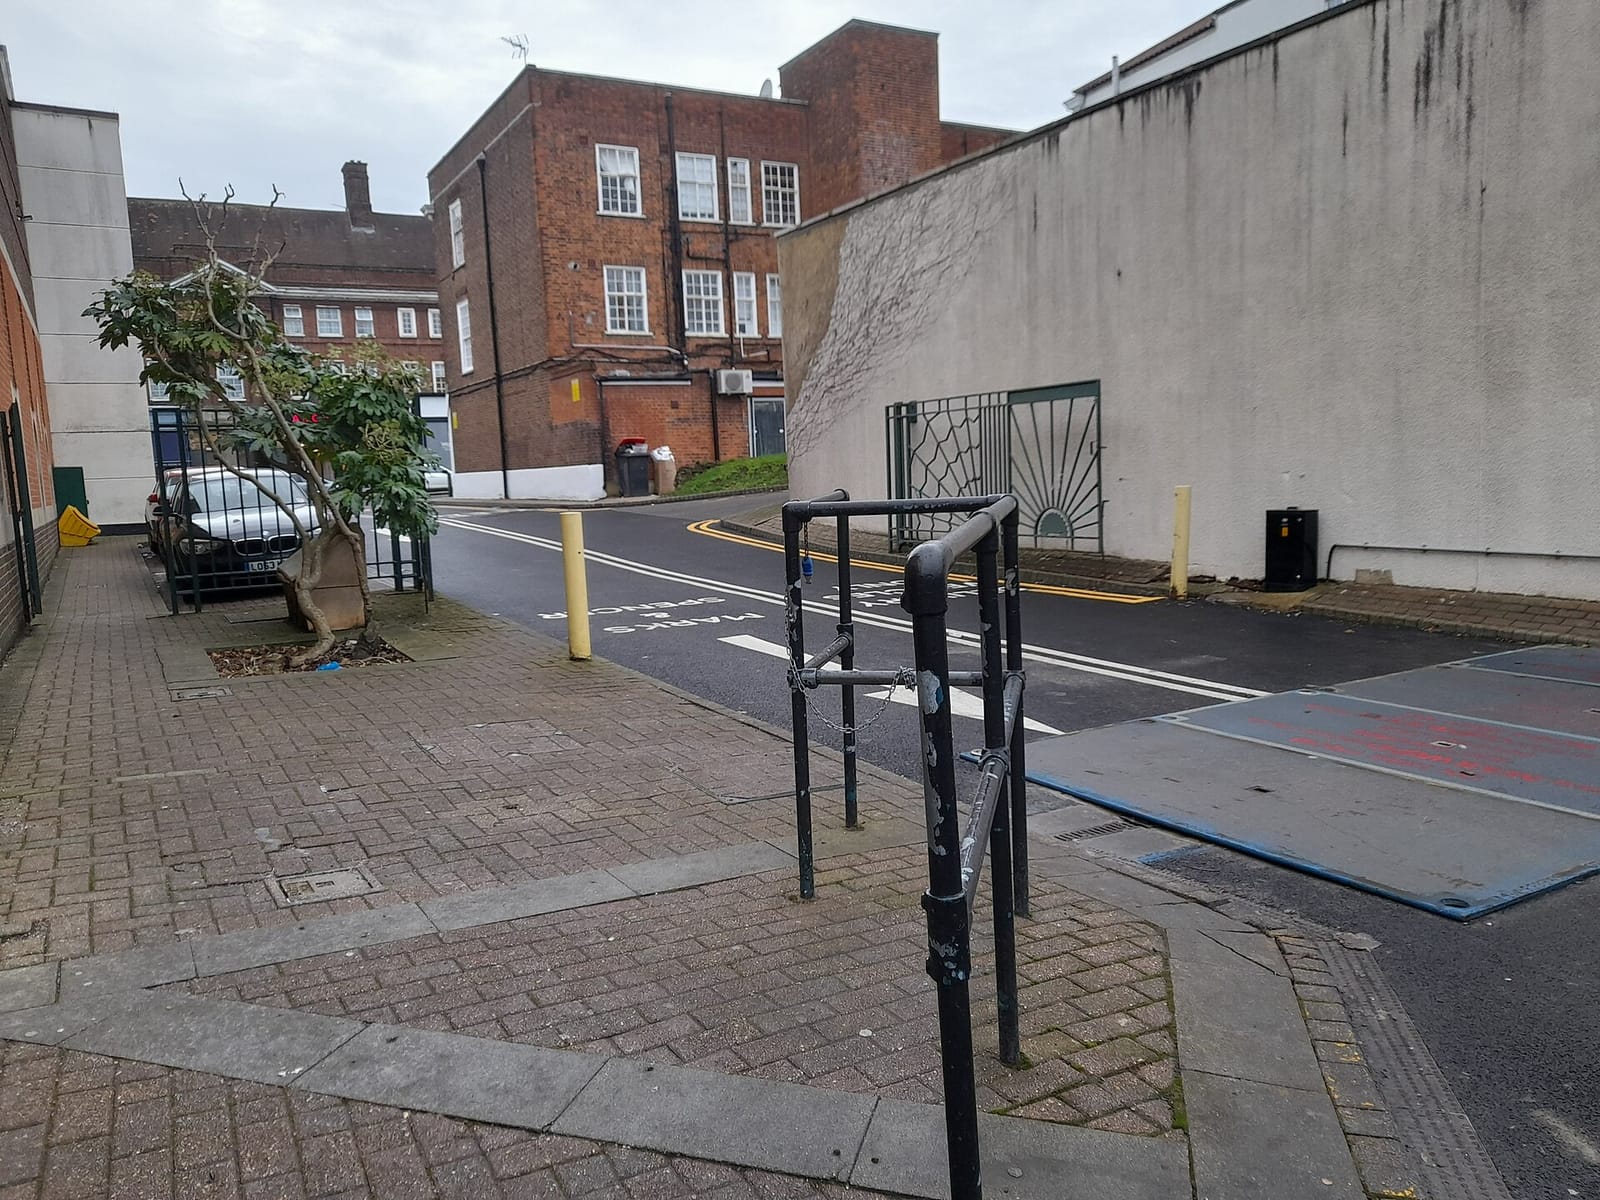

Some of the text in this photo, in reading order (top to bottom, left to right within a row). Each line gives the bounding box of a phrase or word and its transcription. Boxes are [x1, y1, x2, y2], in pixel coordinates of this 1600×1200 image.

[537, 597, 726, 619] SPENCR
[640, 611, 671, 619] &
[603, 612, 765, 633] MARKS
